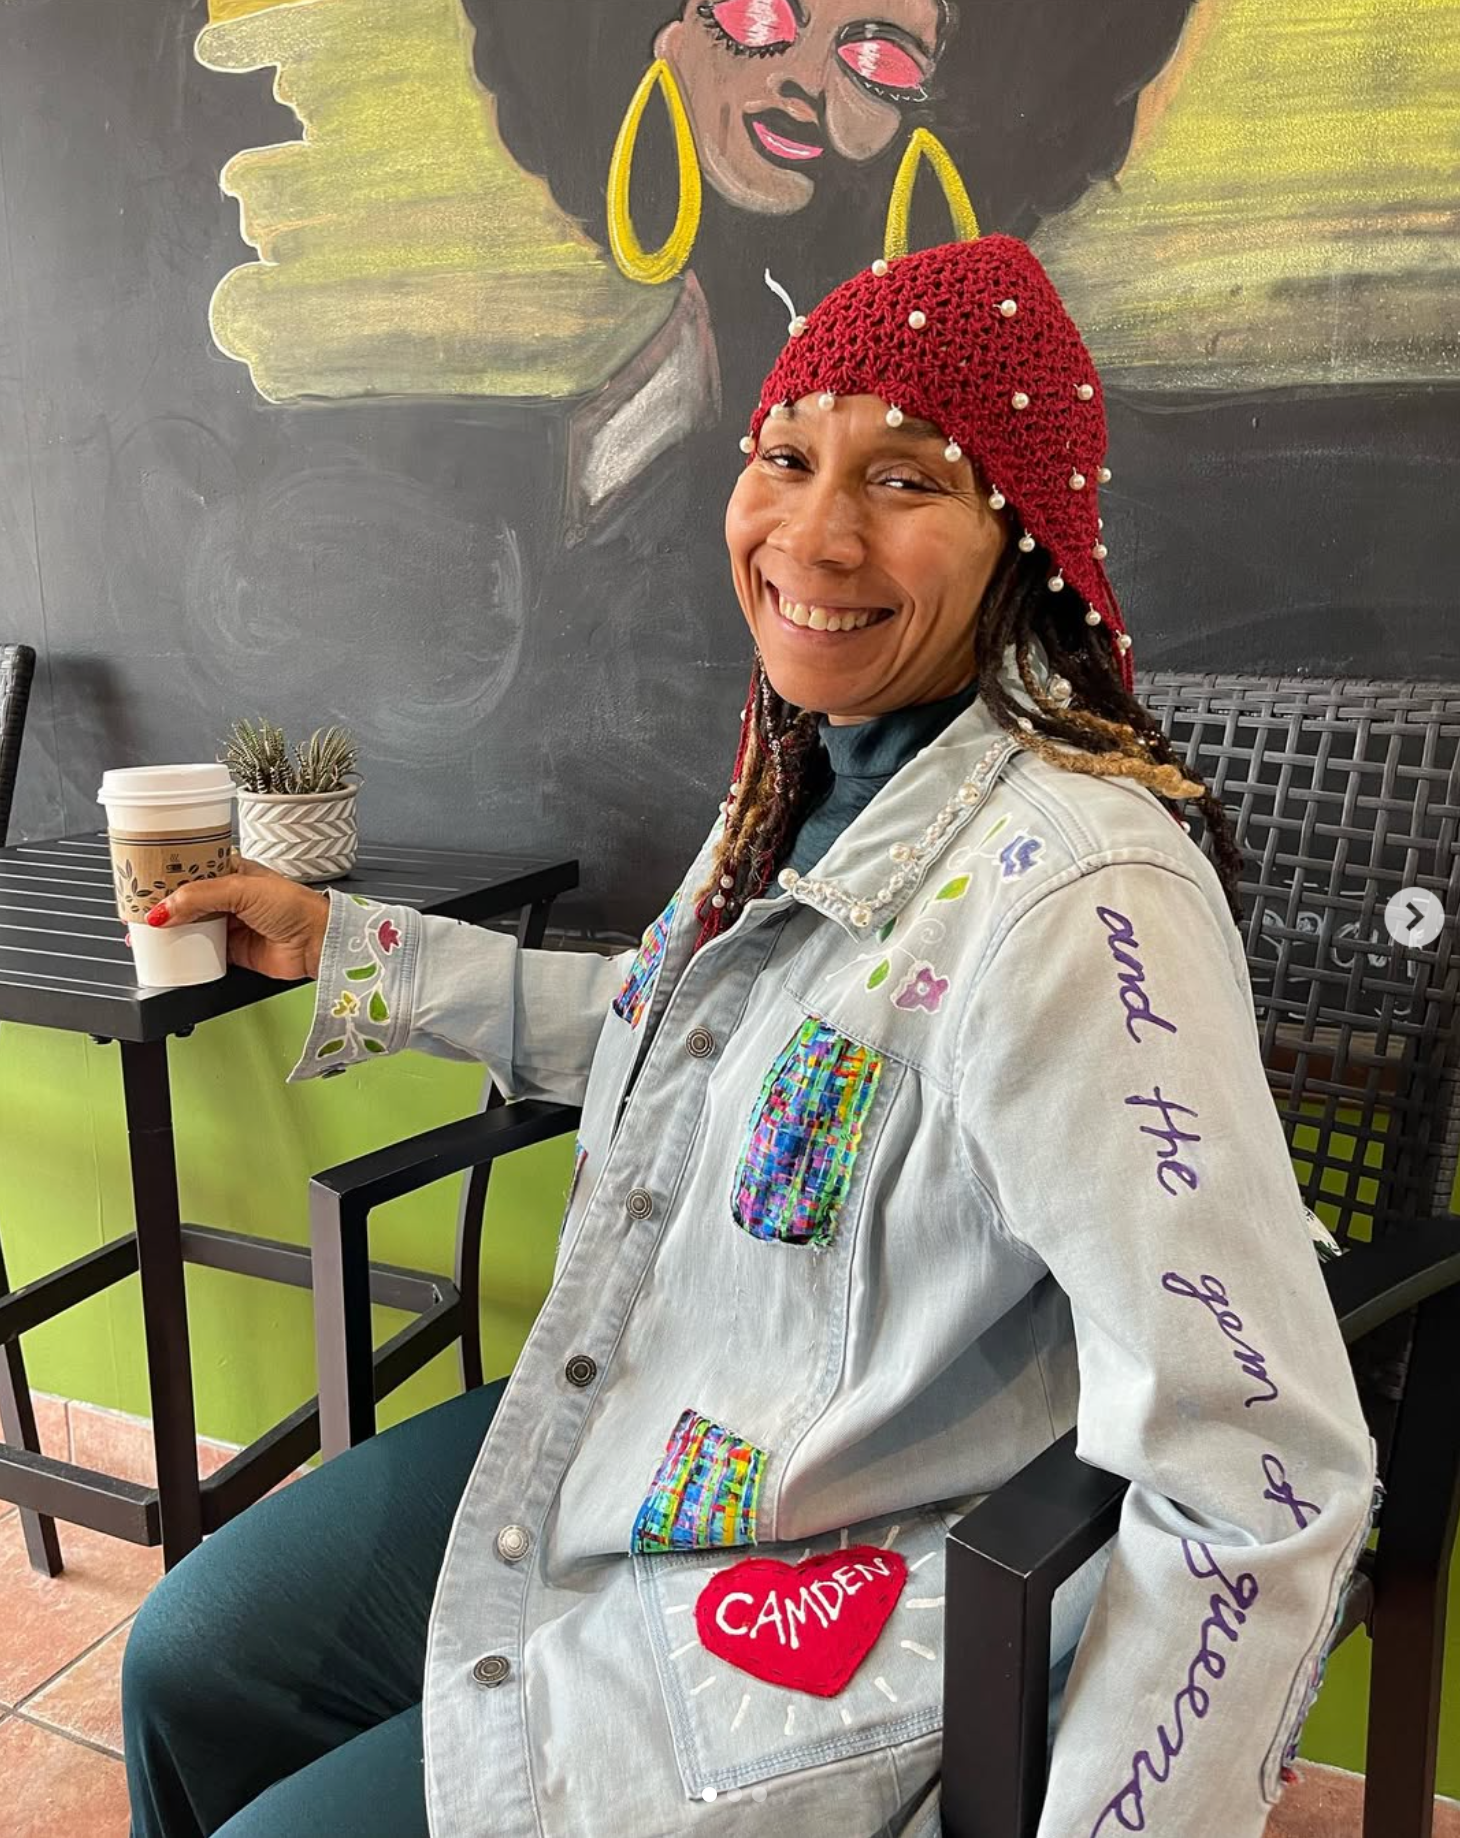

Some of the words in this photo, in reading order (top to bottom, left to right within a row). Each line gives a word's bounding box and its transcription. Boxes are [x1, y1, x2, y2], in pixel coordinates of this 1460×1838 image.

[1096, 906, 1178, 1044] and
[1124, 1086, 1202, 1196] the
[1162, 1272, 1279, 1409] gem
[715, 1557, 892, 1650] CAMDEN
